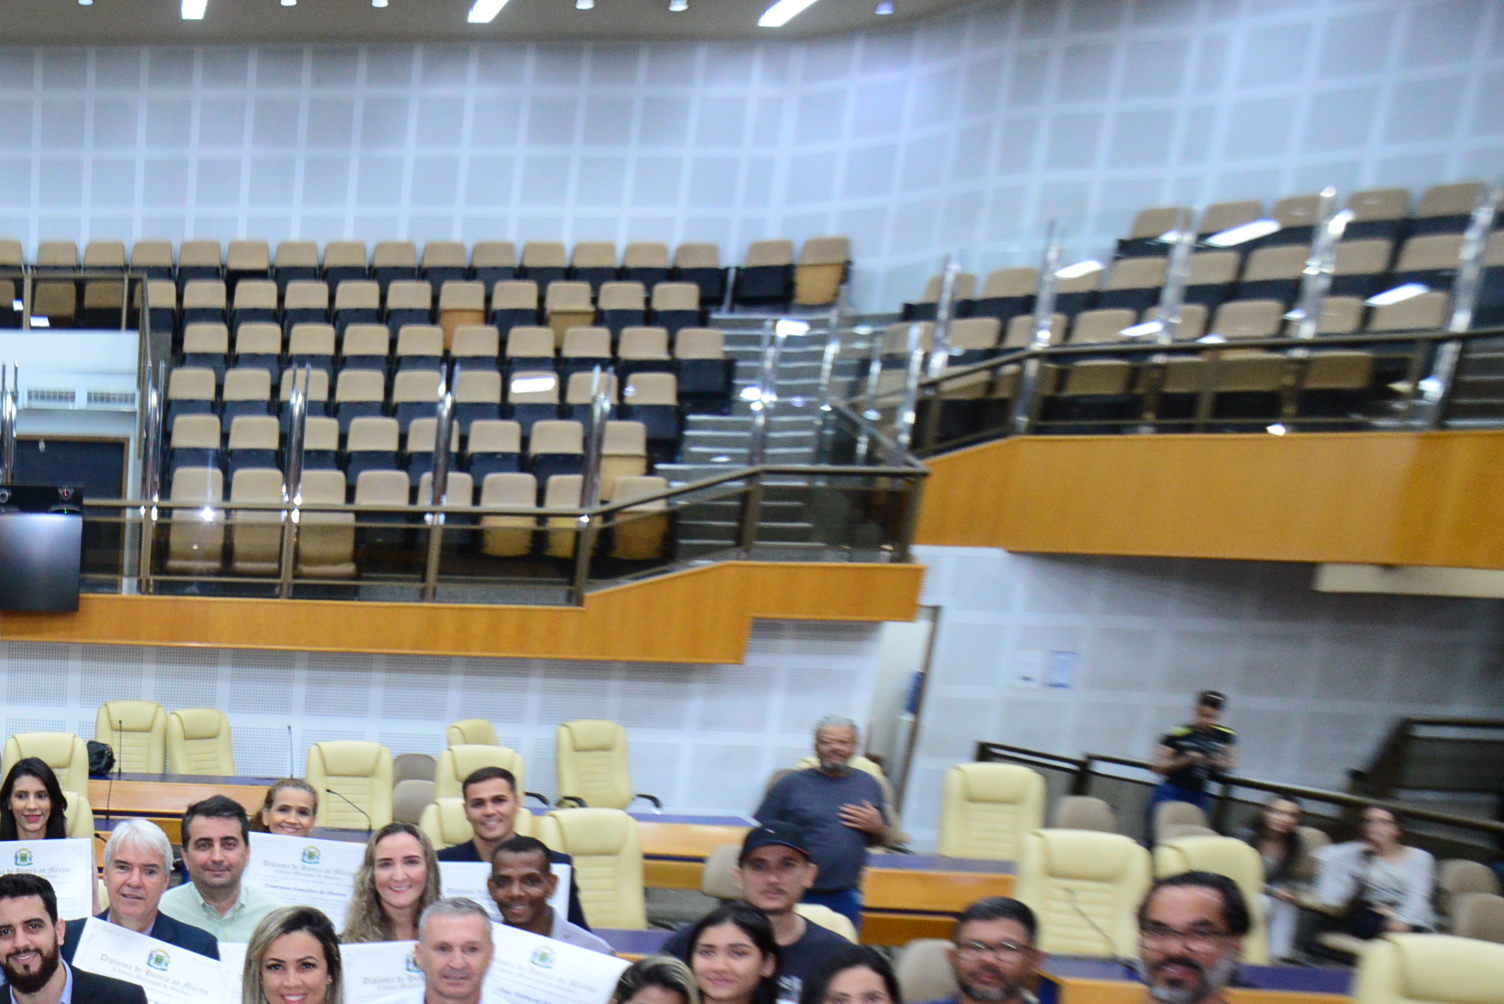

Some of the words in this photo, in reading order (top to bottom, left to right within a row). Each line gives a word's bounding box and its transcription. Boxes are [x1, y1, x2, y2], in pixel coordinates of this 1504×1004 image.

[100, 953, 133, 971] Diploma
[134, 966, 143, 974] de
[146, 969, 170, 983] Honra
[182, 982, 209, 996] Mérito
